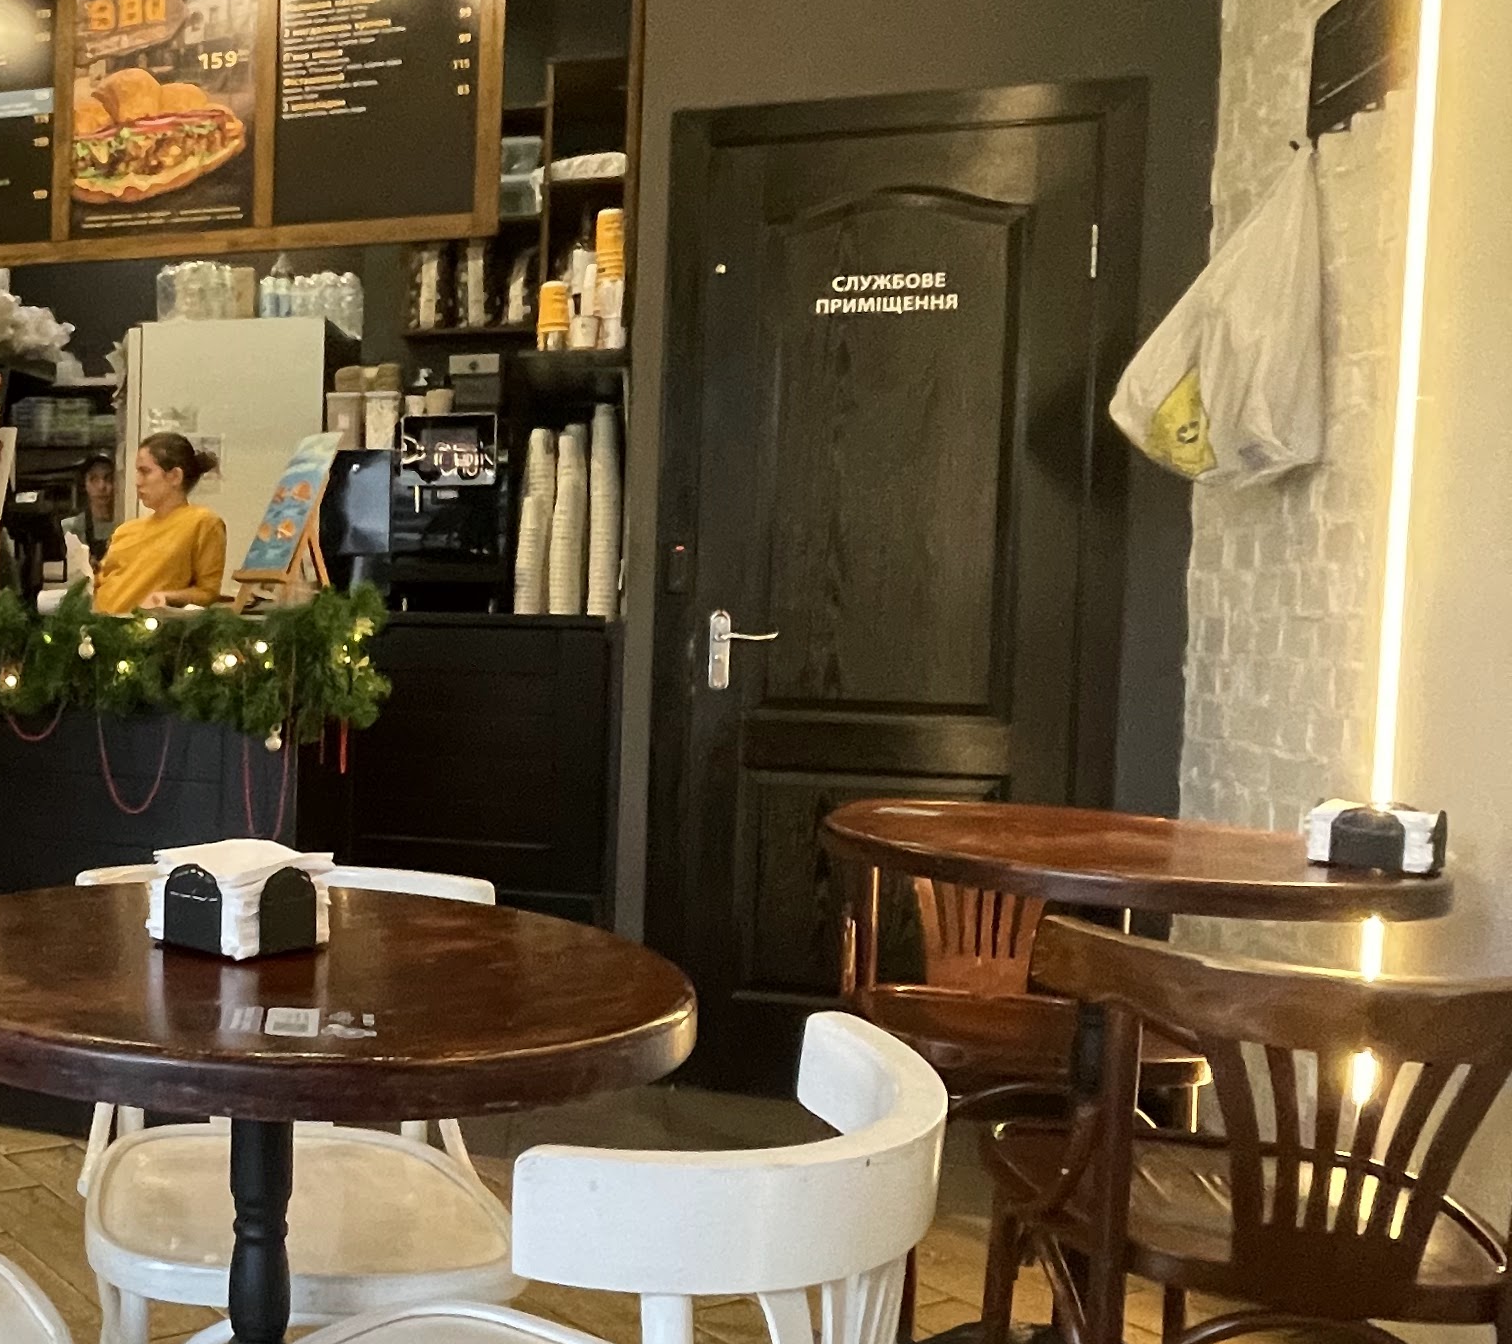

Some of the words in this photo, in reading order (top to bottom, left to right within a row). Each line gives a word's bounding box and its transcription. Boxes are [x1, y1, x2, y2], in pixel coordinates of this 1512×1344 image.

[198, 50, 238, 71] 159
[831, 272, 947, 293] СЛУЖБОВЕ
[815, 293, 959, 314] ПРИМІЩЕННЯ
